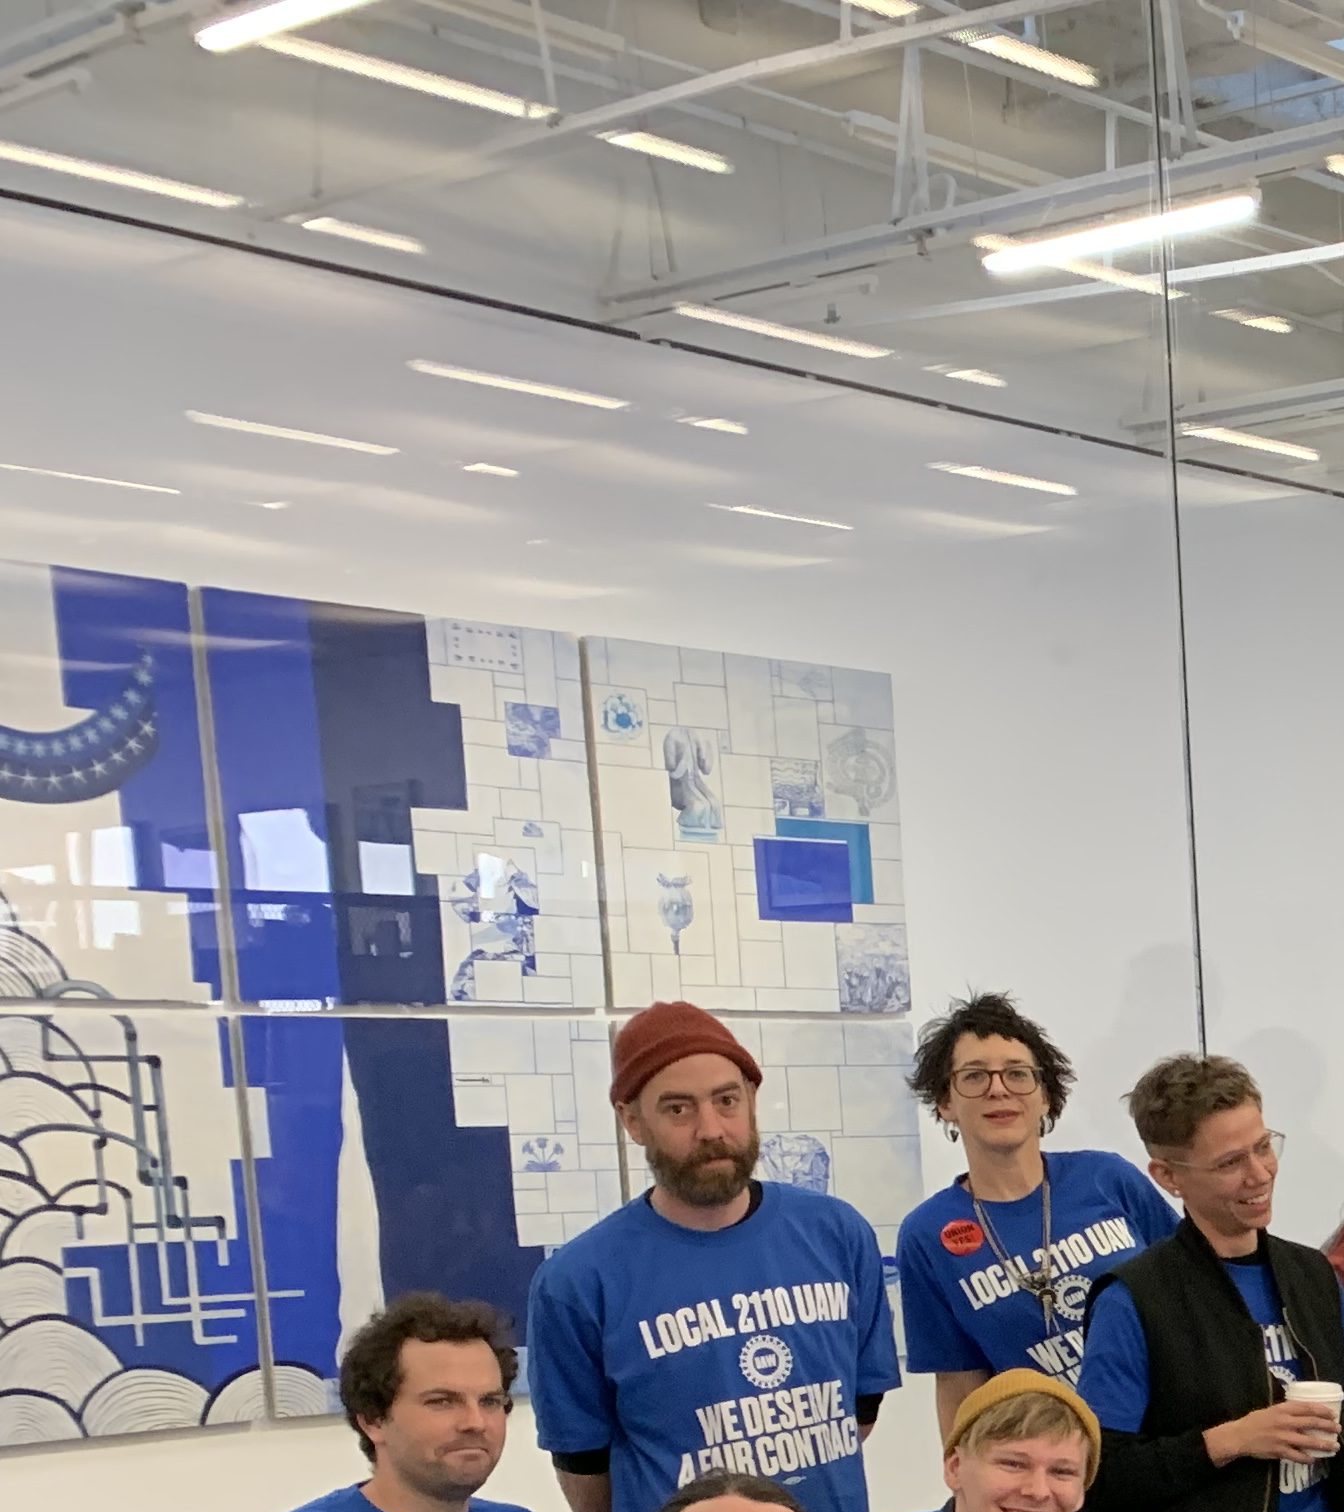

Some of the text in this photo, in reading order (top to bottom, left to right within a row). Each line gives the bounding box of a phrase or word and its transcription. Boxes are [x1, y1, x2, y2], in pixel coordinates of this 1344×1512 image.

[944, 1223, 975, 1240] UNION
[1084, 1217, 1136, 1257] UAW
[640, 1281, 850, 1360] LOCAL 2110 UAW
[1026, 1335, 1080, 1374] WE
[696, 1402, 740, 1446] WE
[677, 1456, 696, 1489] A
[758, 1416, 859, 1478] CONTRAC
